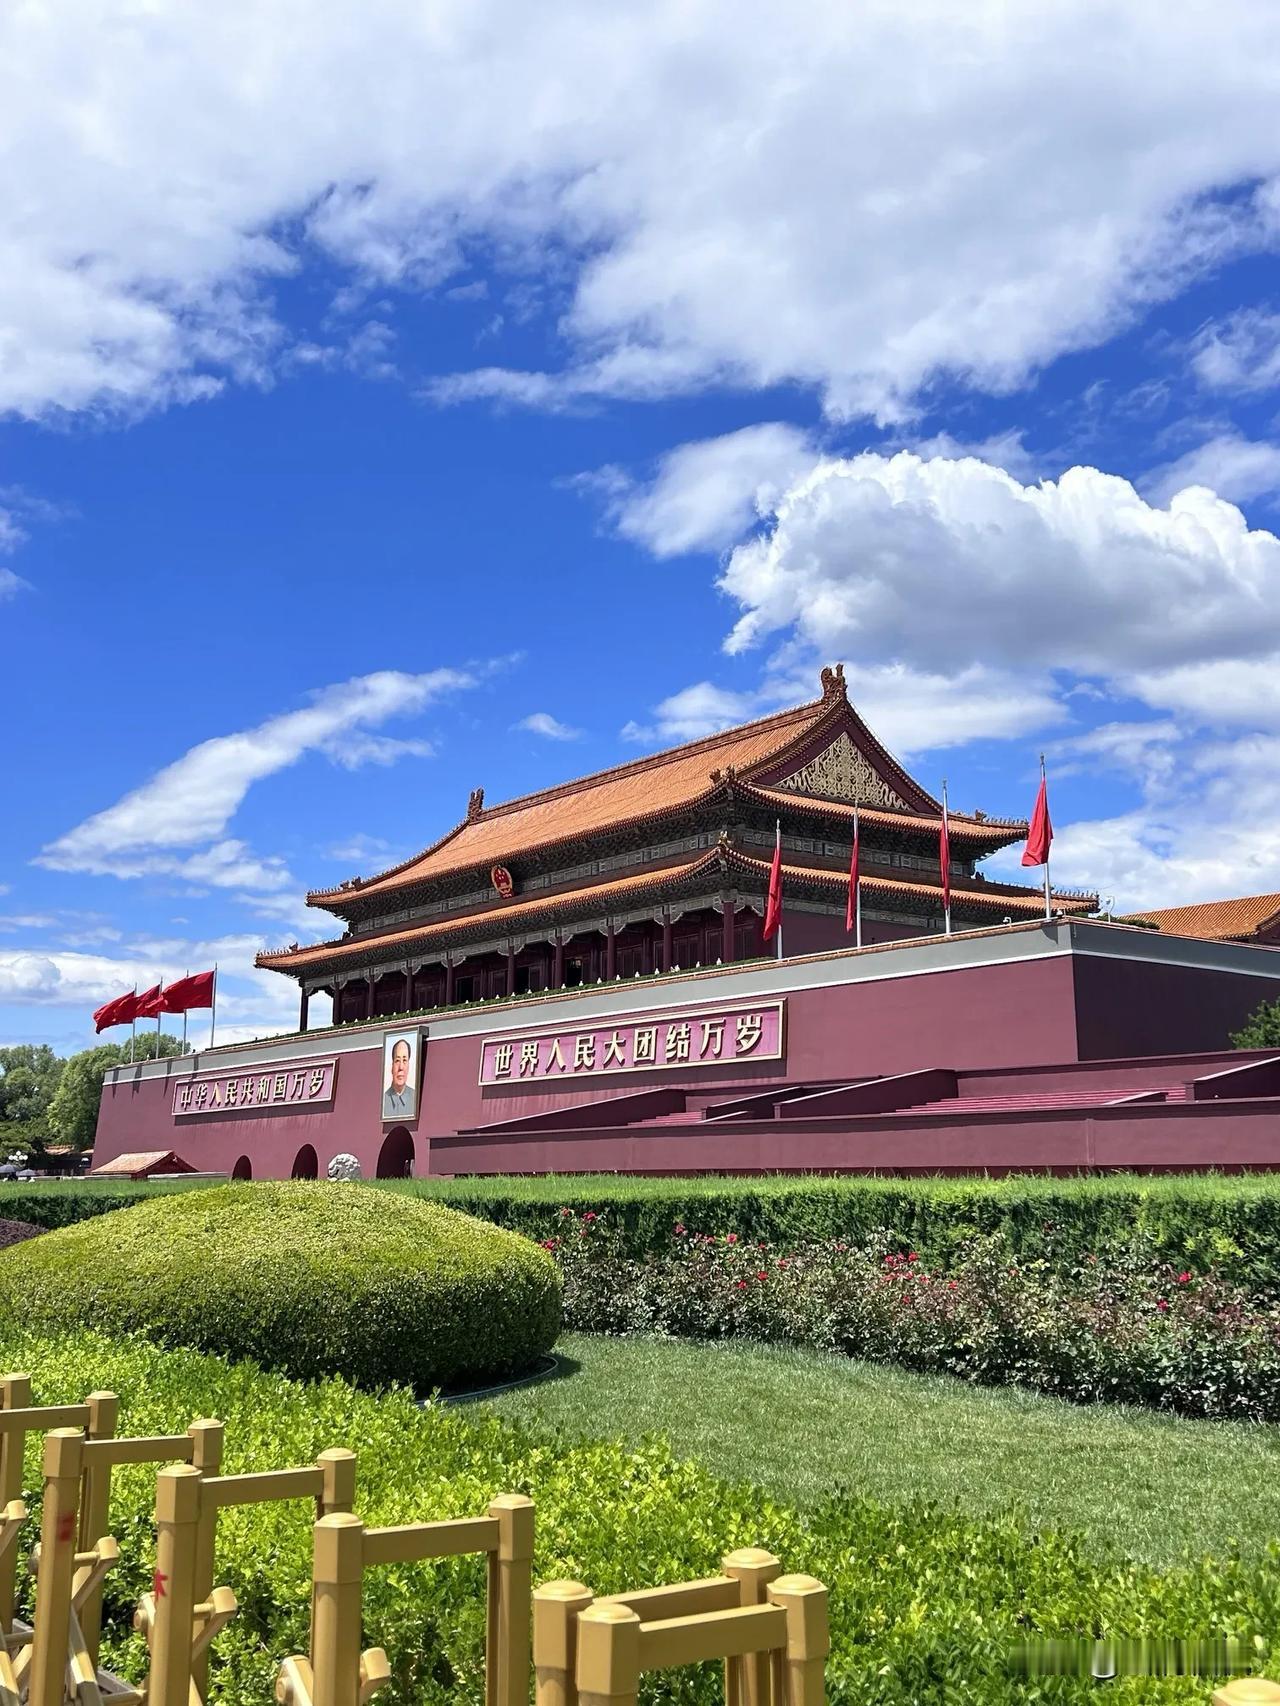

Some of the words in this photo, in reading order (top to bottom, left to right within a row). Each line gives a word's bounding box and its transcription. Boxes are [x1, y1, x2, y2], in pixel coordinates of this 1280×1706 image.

[494, 1014, 763, 1077] 世界人民大团结万岁
[180, 1068, 326, 1110] 中华人民共和国万岁
